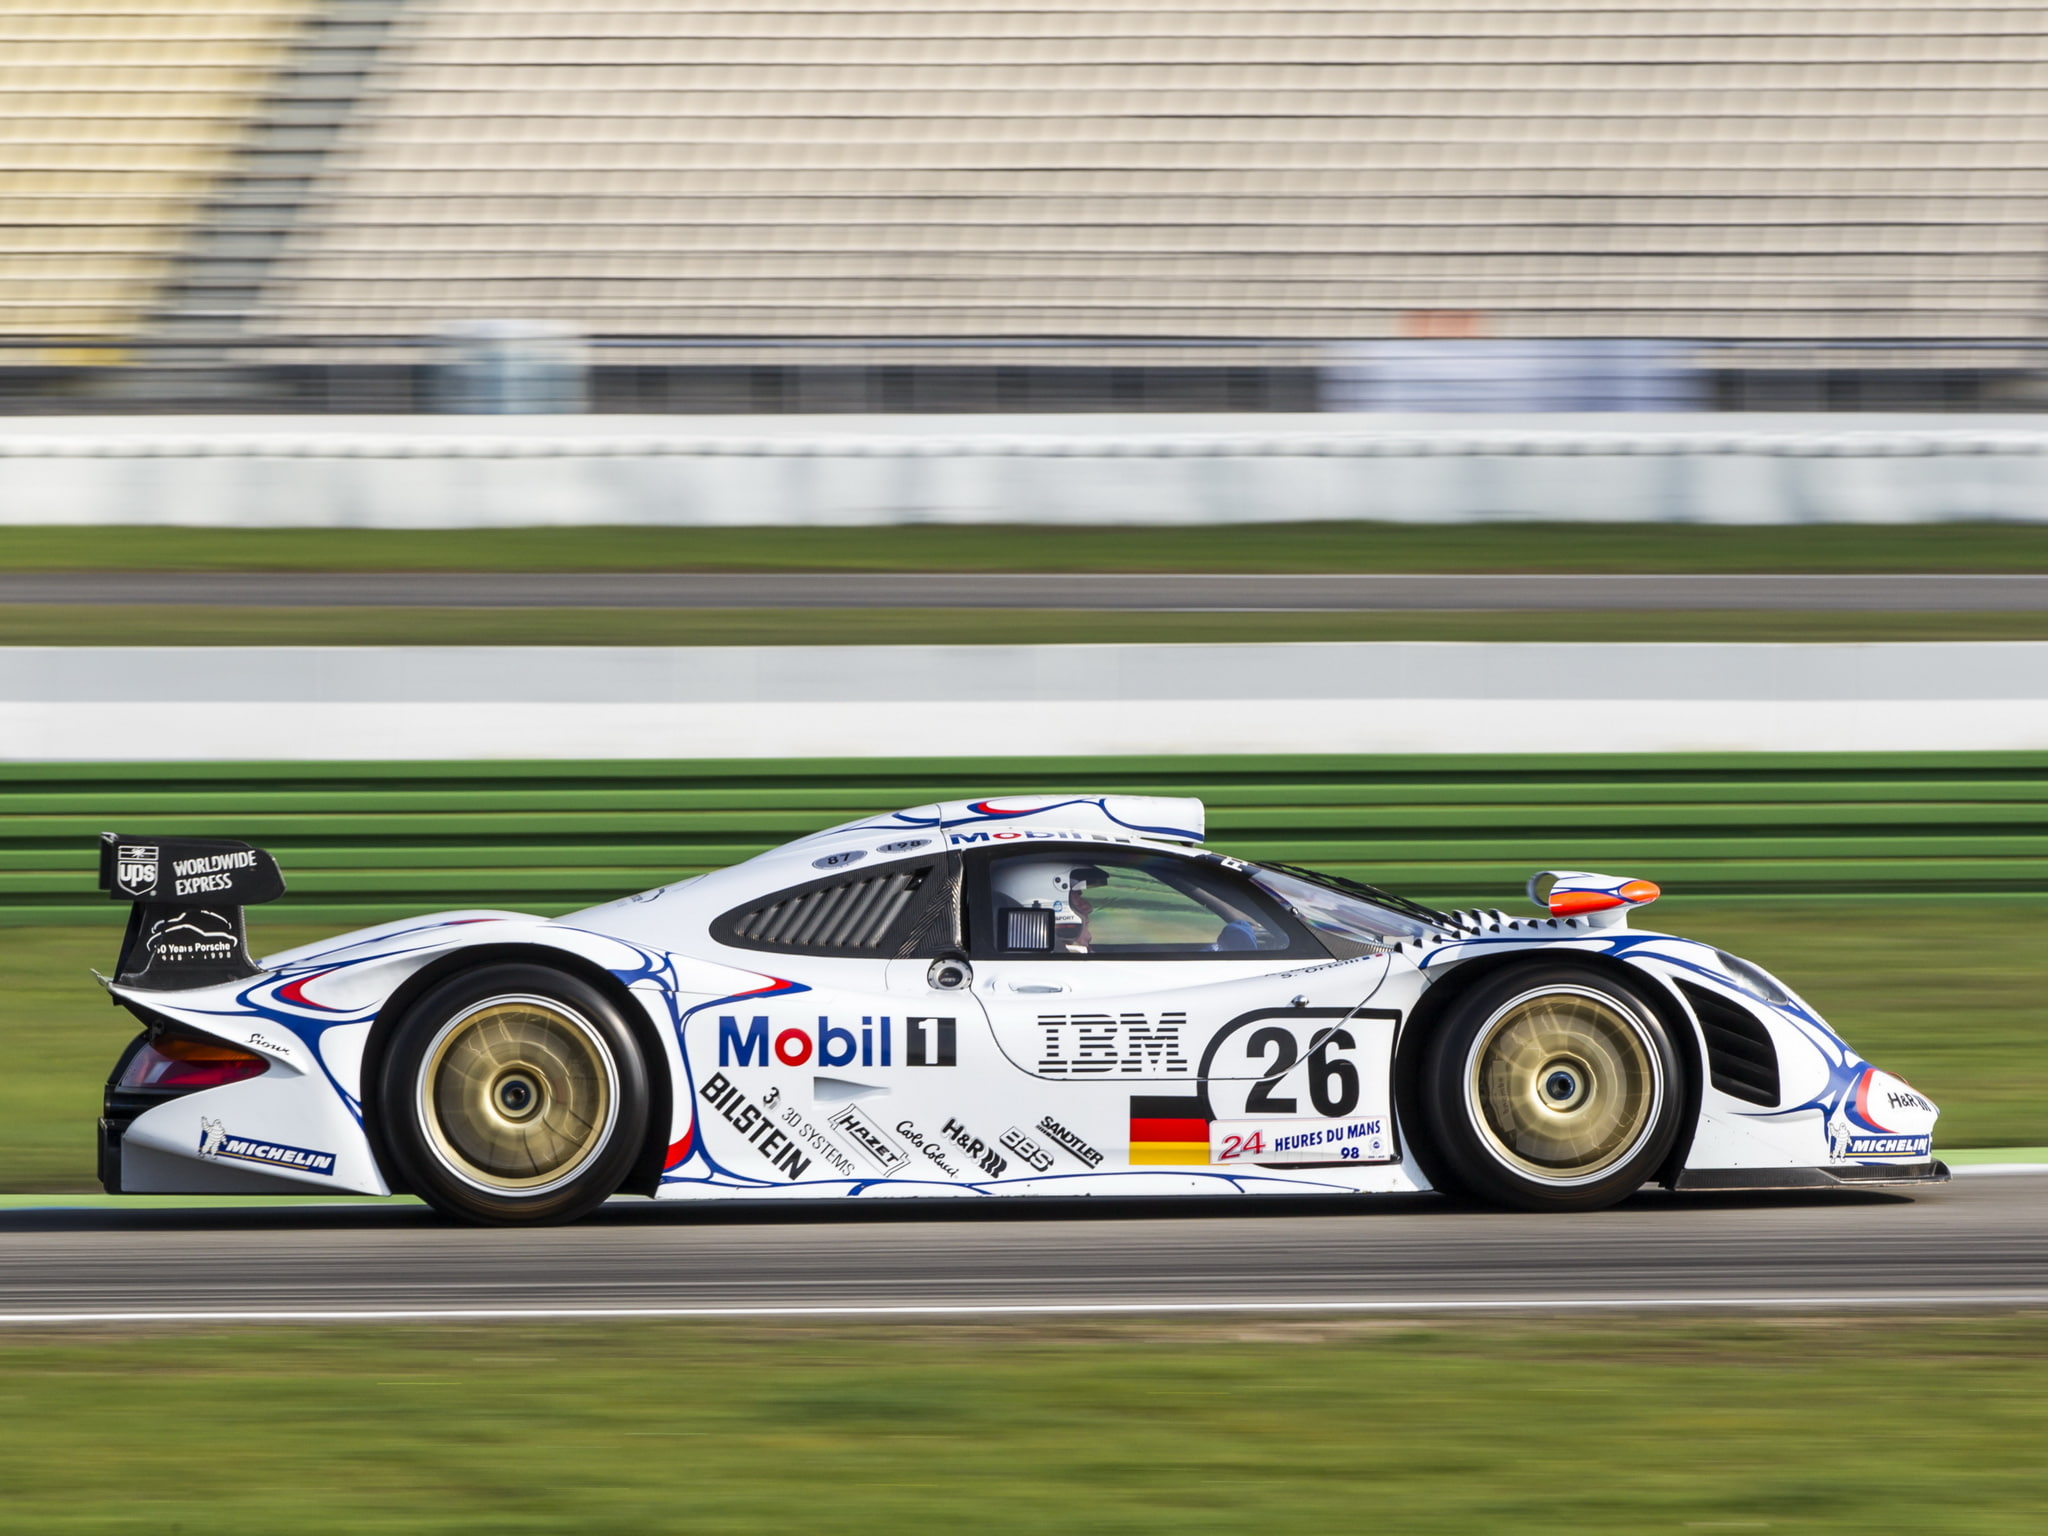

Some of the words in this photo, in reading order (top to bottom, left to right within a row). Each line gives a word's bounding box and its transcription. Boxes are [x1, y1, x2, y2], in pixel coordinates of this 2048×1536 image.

[949, 831, 1082, 845] Mobil
[120, 864, 155, 887] ups
[173, 851, 257, 877] WORLDWIDE
[828, 853, 850, 865] 87
[175, 873, 232, 896] EXPRESS
[168, 943, 193, 953] Years
[195, 941, 230, 952] Porsche
[719, 1016, 891, 1067] Mobil
[1038, 1012, 1187, 1073] IBM
[1245, 1026, 1360, 1118] 26
[1886, 1092, 1918, 1109] H&R
[699, 1071, 812, 1181] BILSTEIN
[781, 1107, 802, 1128] 3D
[798, 1123, 855, 1177] SYSTEMS
[839, 1114, 899, 1163] HAZET
[941, 1117, 985, 1160] H&R
[1040, 1115, 1104, 1166] SANDTLER
[1219, 1130, 1266, 1160] 24
[1275, 1131, 1322, 1152] HEURES
[1326, 1127, 1343, 1142] DU
[1347, 1120, 1381, 1139] MANS
[1851, 1137, 1928, 1154] MICHELIN
[225, 1140, 333, 1169] MICHELIN
[896, 1120, 922, 1148] Carlo
[922, 1143, 959, 1178] Colucci
[1000, 1126, 1054, 1172] BBS
[1340, 1147, 1360, 1159] 98
